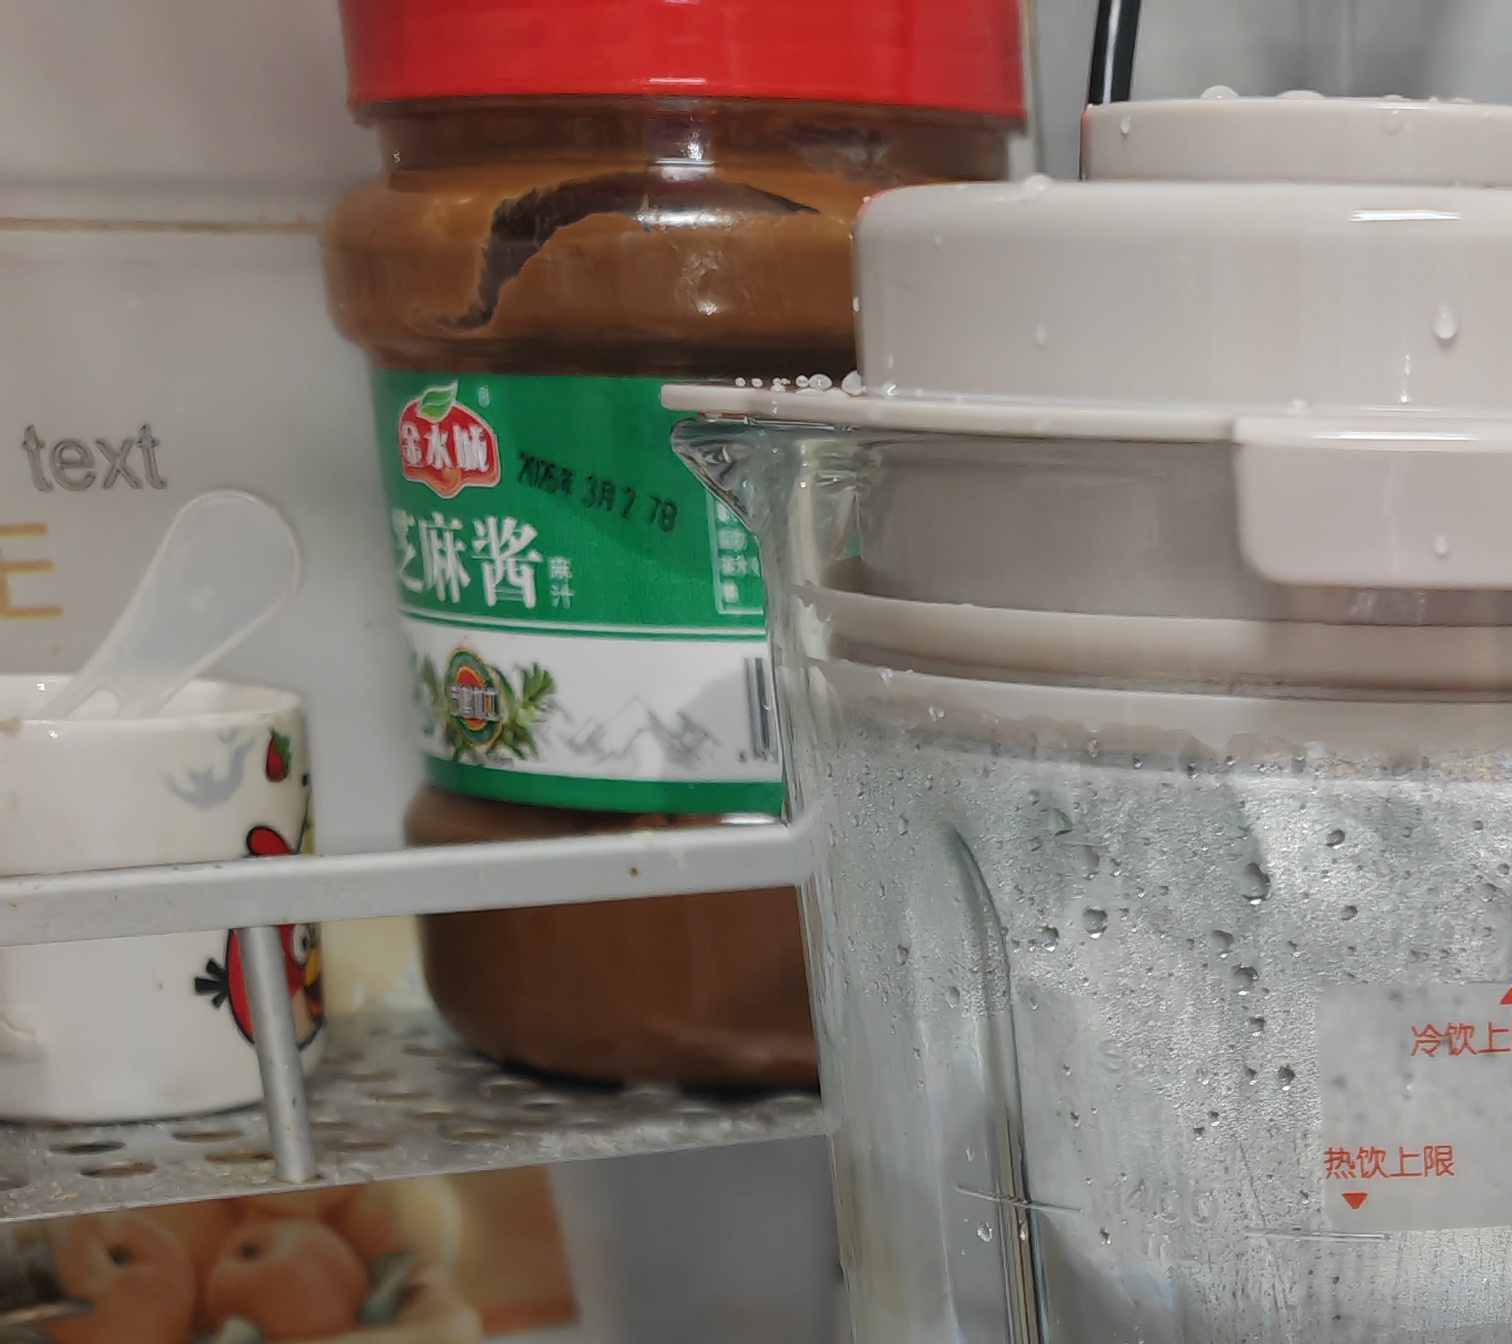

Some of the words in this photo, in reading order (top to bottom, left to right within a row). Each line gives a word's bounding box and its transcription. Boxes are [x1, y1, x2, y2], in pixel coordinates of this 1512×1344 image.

[22, 423, 168, 491] text
[1323, 1145, 1455, 1180] 热饮上限
